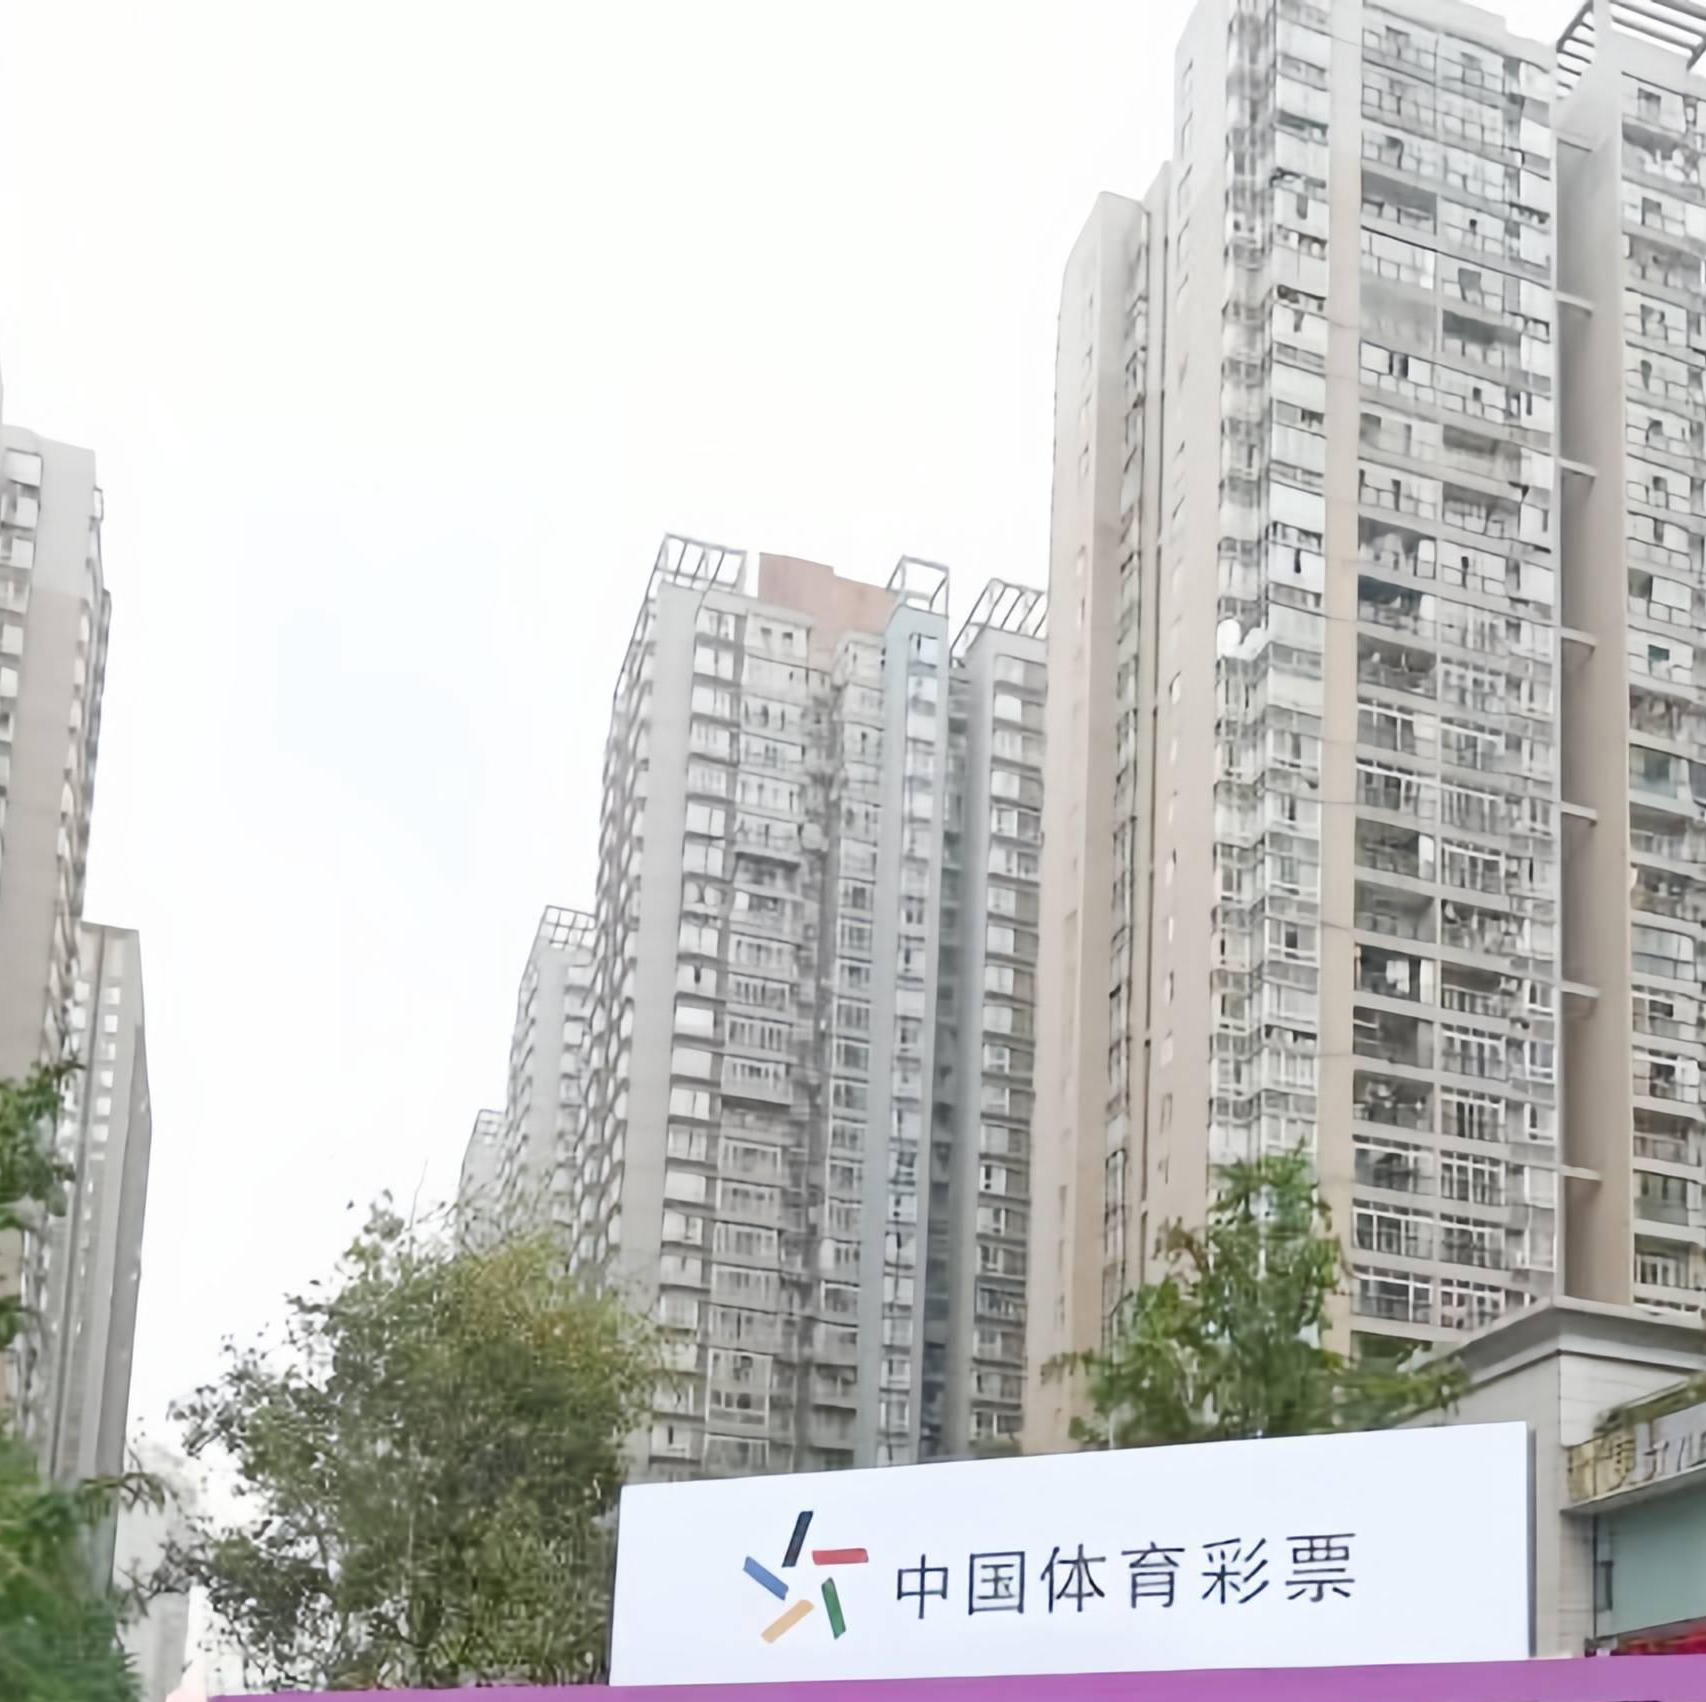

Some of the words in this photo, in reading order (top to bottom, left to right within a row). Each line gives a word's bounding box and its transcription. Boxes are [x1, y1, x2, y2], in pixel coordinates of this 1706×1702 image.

[895, 1531, 1358, 1621] 中国体育彩票
